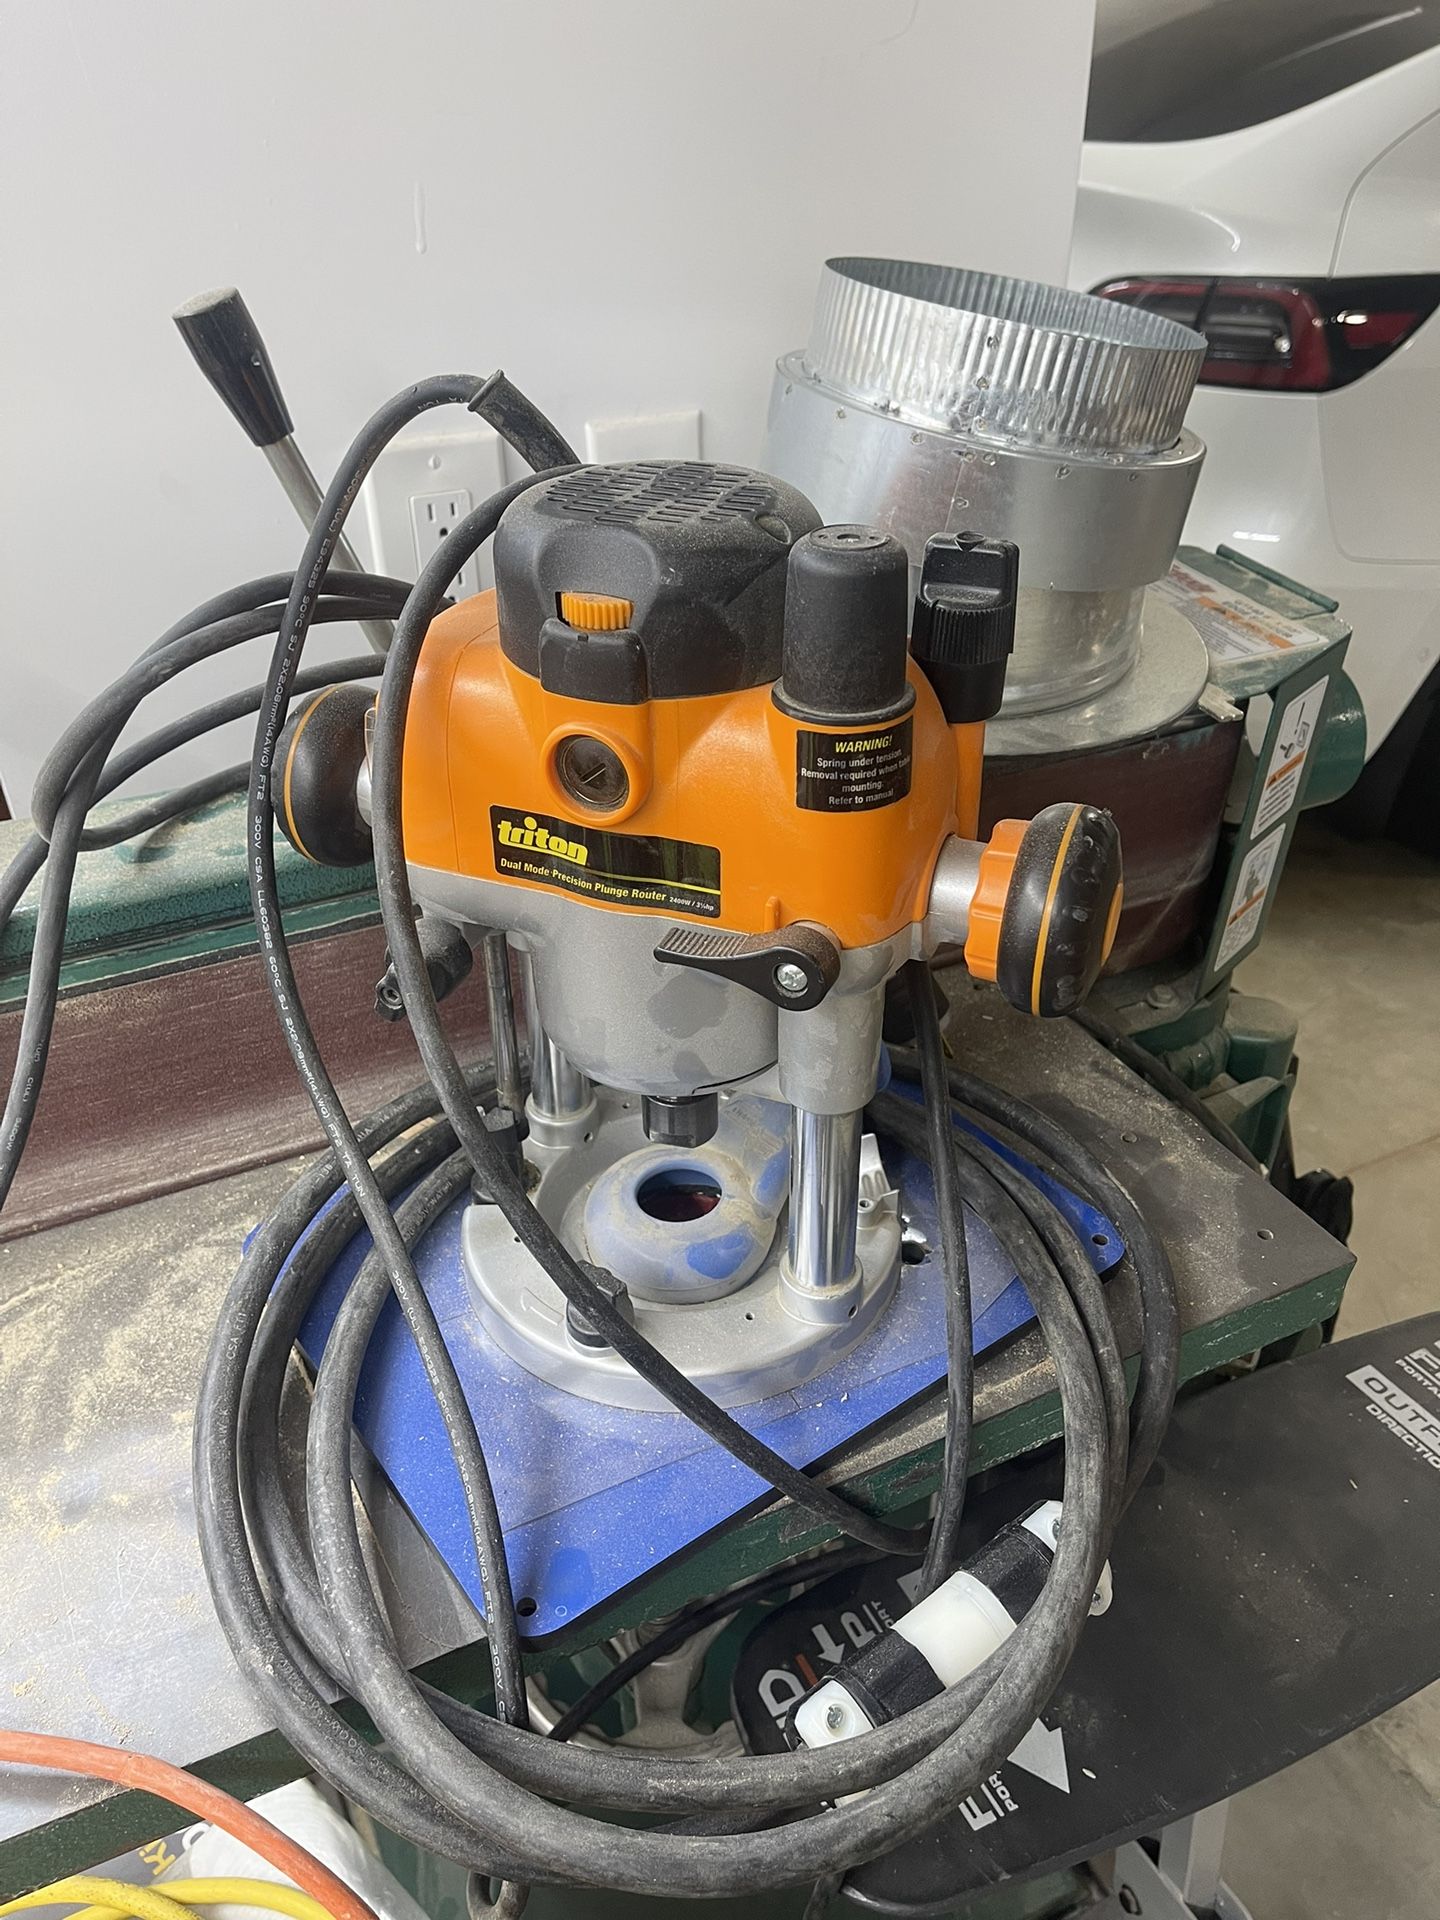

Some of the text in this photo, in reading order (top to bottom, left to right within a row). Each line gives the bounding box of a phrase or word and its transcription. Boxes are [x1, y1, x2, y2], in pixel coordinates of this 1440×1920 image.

[287, 634, 298, 651] SJ
[835, 735, 893, 753] WARNING!
[817, 749, 902, 769] Spring under tension
[801, 768, 838, 780] Removal
[840, 768, 877, 781] required
[879, 763, 898, 775] when
[256, 774, 265, 800] FT2
[829, 788, 894, 805] Refer to manual
[253, 815, 262, 848] 300V
[498, 816, 588, 866] triton
[254, 856, 262, 882] CSA
[501, 858, 522, 870] Dual
[524, 863, 549, 877] Mode
[552, 867, 592, 890] Precision
[595, 883, 628, 898] Plunge
[631, 888, 667, 901] Router
[277, 993, 288, 1010] SJ
[326, 1122, 343, 1147] FT2
[391, 1269, 409, 1301] 300V
[405, 1306, 421, 1331] (UL)
[484, 1590, 494, 1623] FT2
[491, 1643, 502, 1689] 300V
[498, 1701, 506, 1724] CS
